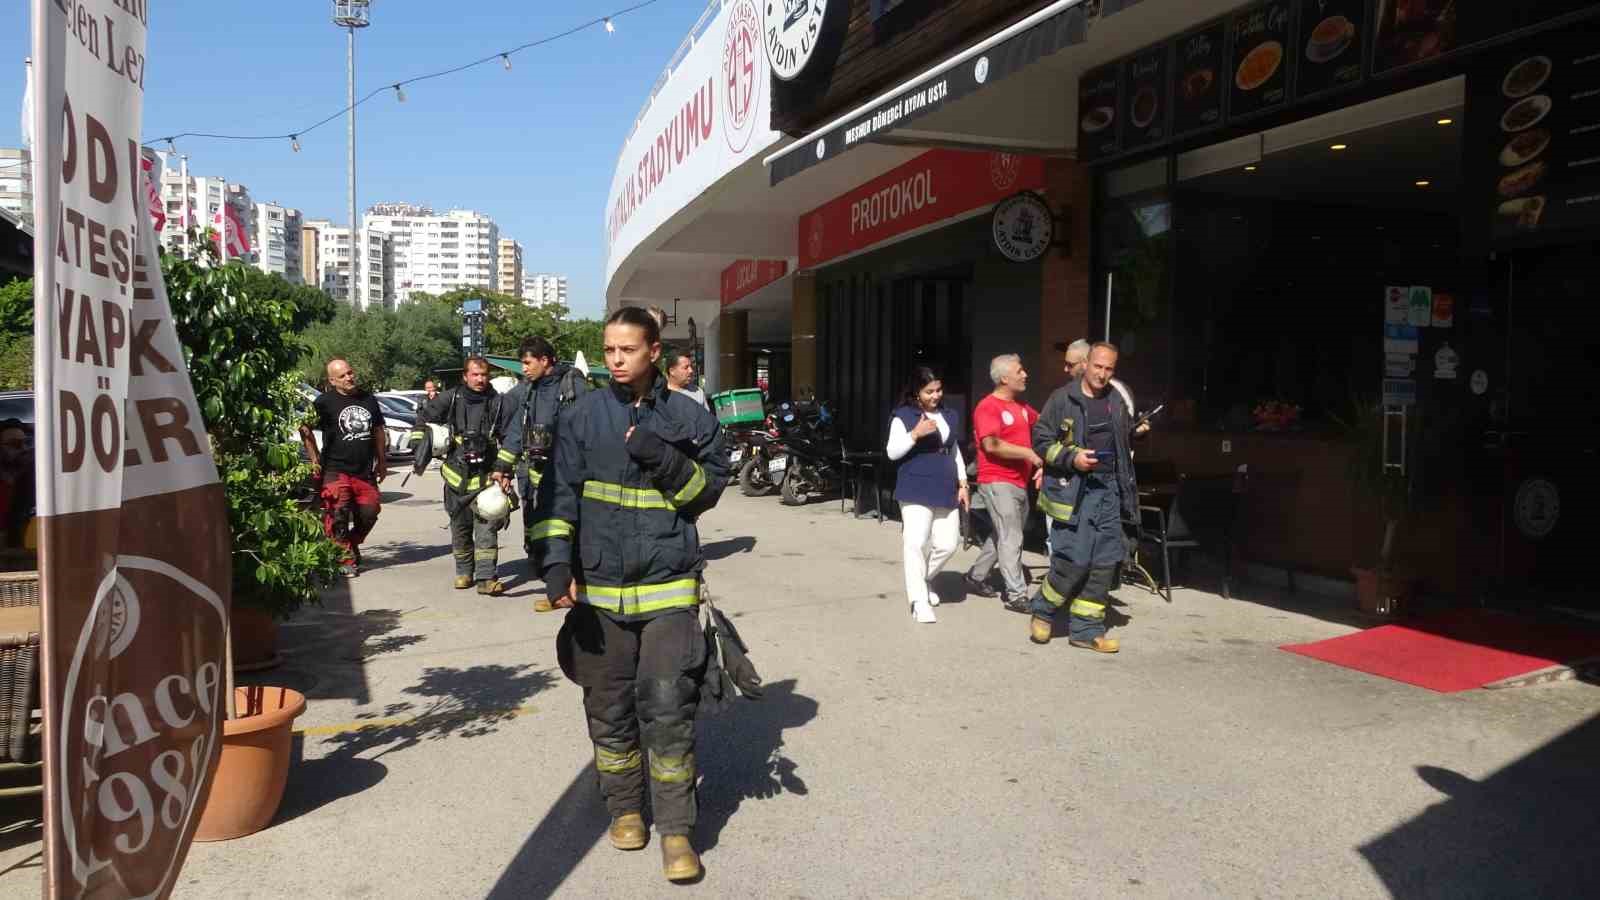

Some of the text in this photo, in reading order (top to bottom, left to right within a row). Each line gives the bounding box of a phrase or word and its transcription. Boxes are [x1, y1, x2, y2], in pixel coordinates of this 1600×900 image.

[768, 26, 798, 70] AYDIN
[872, 100, 903, 132] DÖNERCİ
[904, 90, 926, 116] AYDIN
[928, 79, 947, 104] USTA
[638, 76, 713, 206] STADYUMU
[850, 168, 937, 234] PROTOKOL
